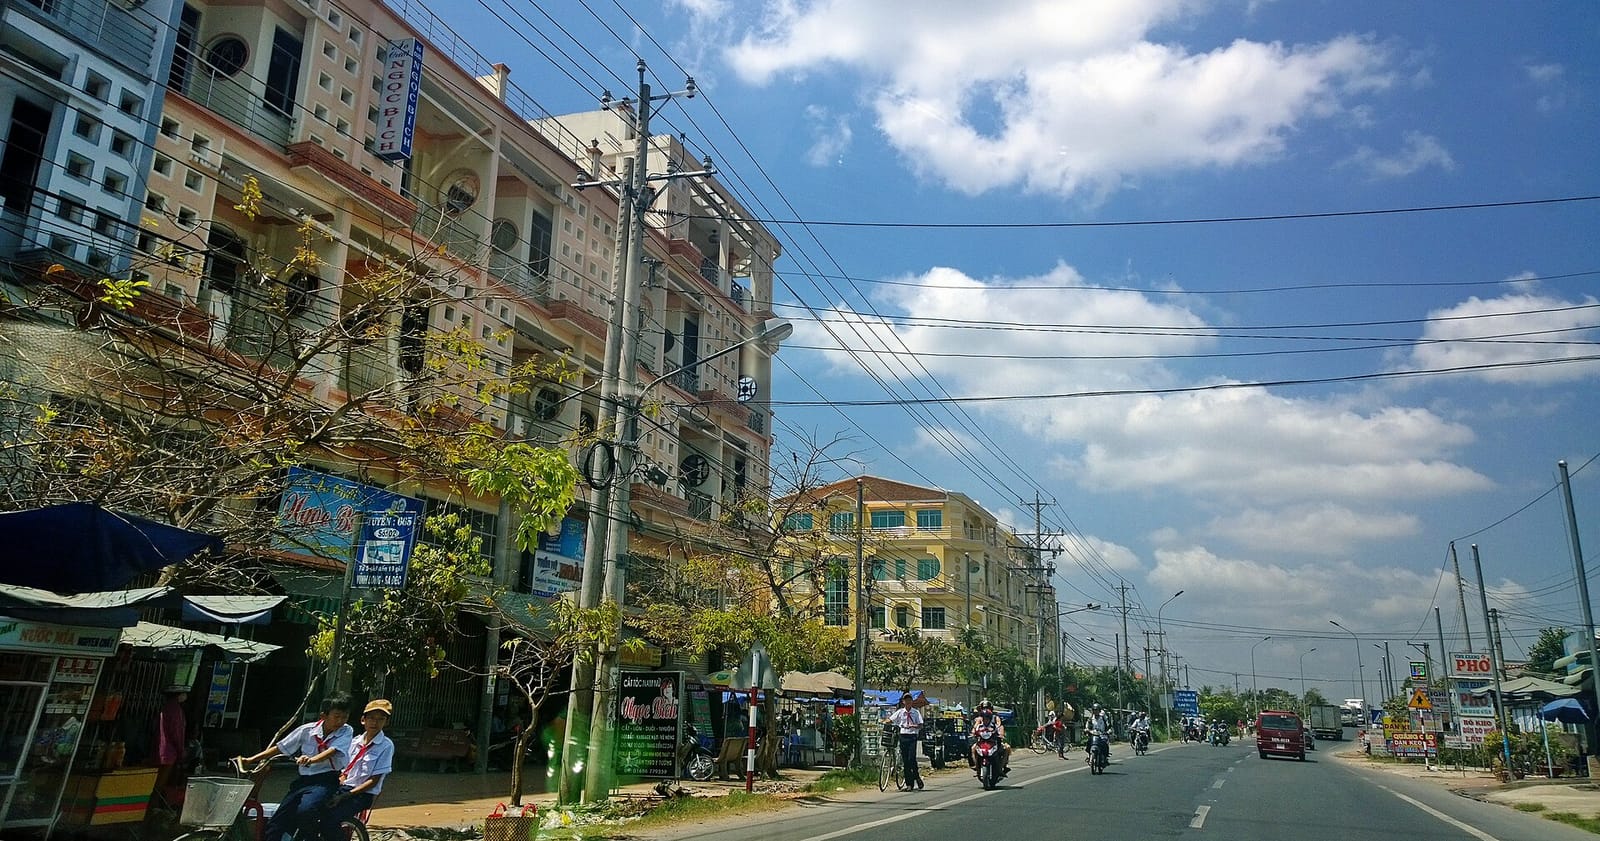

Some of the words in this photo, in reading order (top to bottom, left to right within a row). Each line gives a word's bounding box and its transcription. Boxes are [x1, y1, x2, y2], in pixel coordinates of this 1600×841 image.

[386, 59, 405, 103] NGỌC
[380, 106, 399, 151] BÍCH
[397, 516, 412, 526] 665
[621, 696, 651, 725] Ngọc
